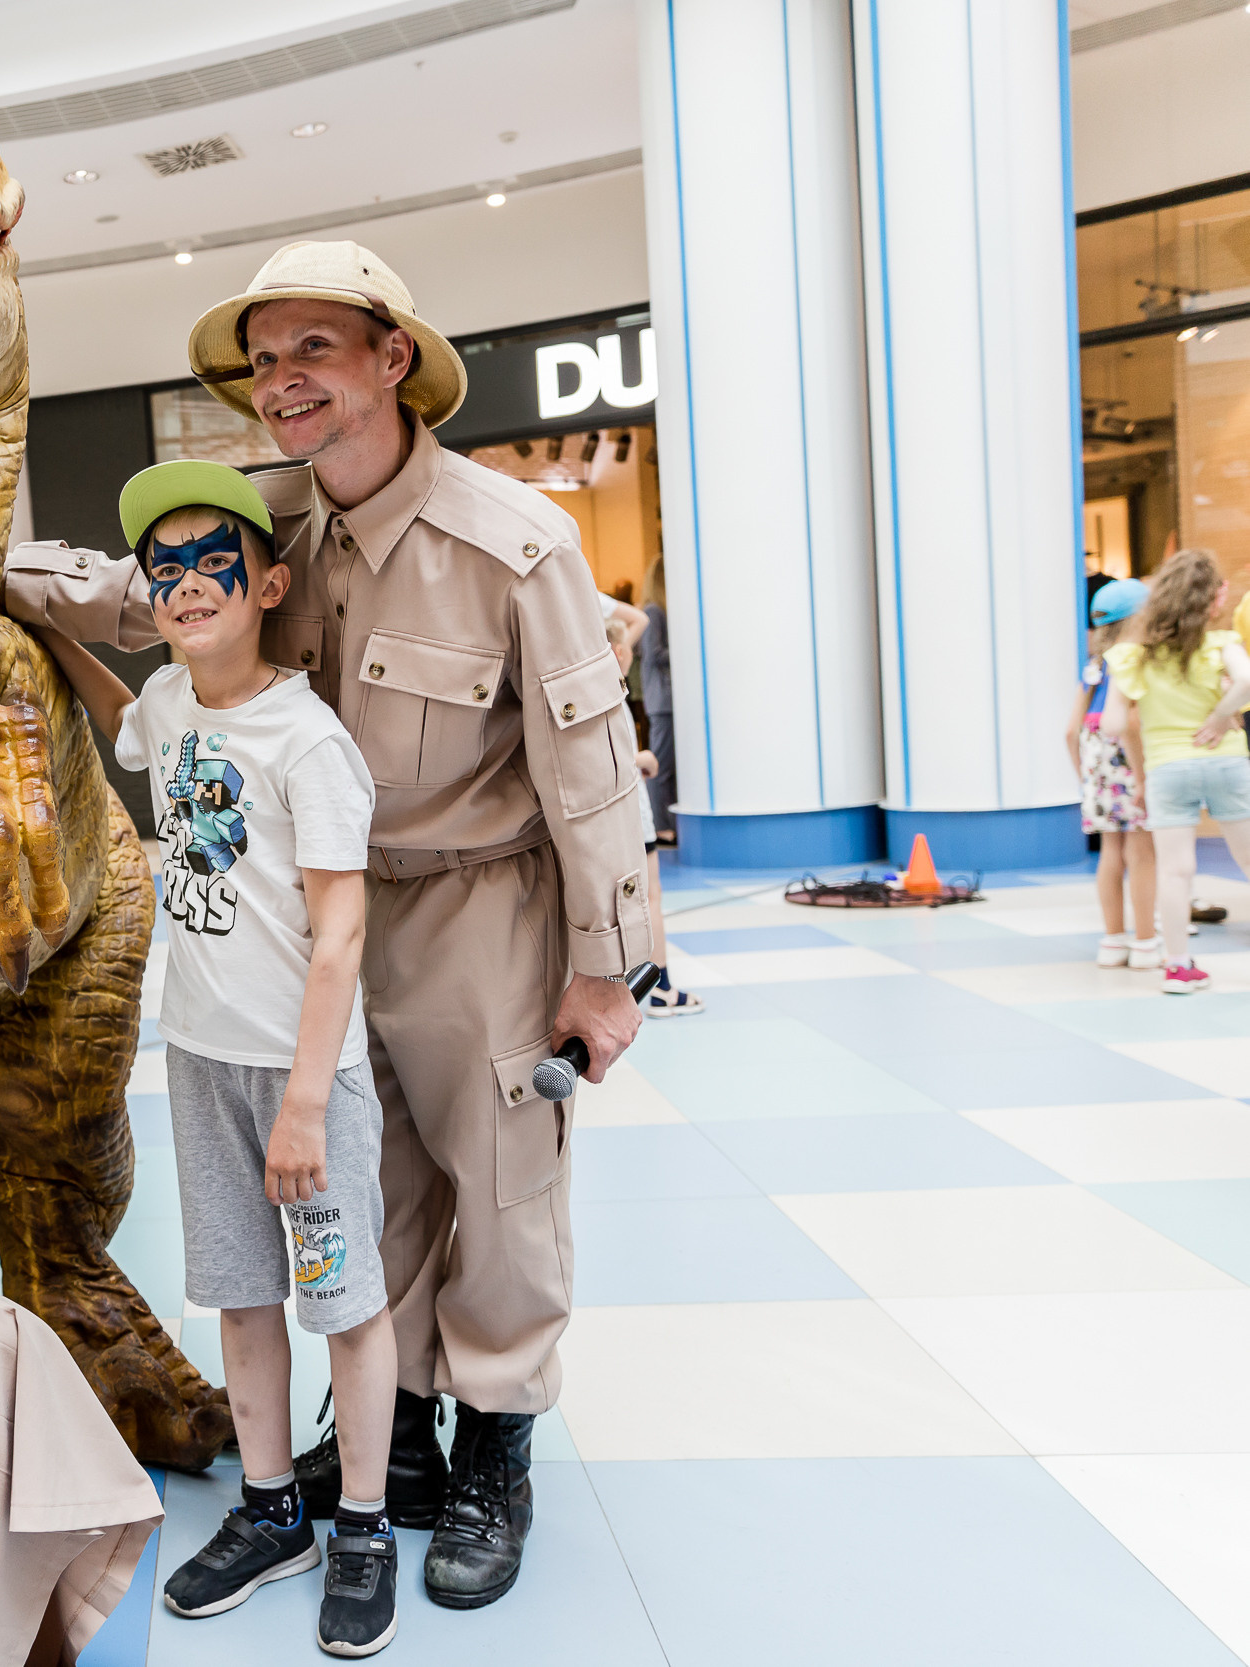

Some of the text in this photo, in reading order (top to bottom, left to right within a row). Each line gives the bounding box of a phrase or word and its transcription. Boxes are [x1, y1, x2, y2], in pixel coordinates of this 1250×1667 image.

[303, 1208, 340, 1225] RIDER
[299, 1286, 346, 1300] THE BEACH
